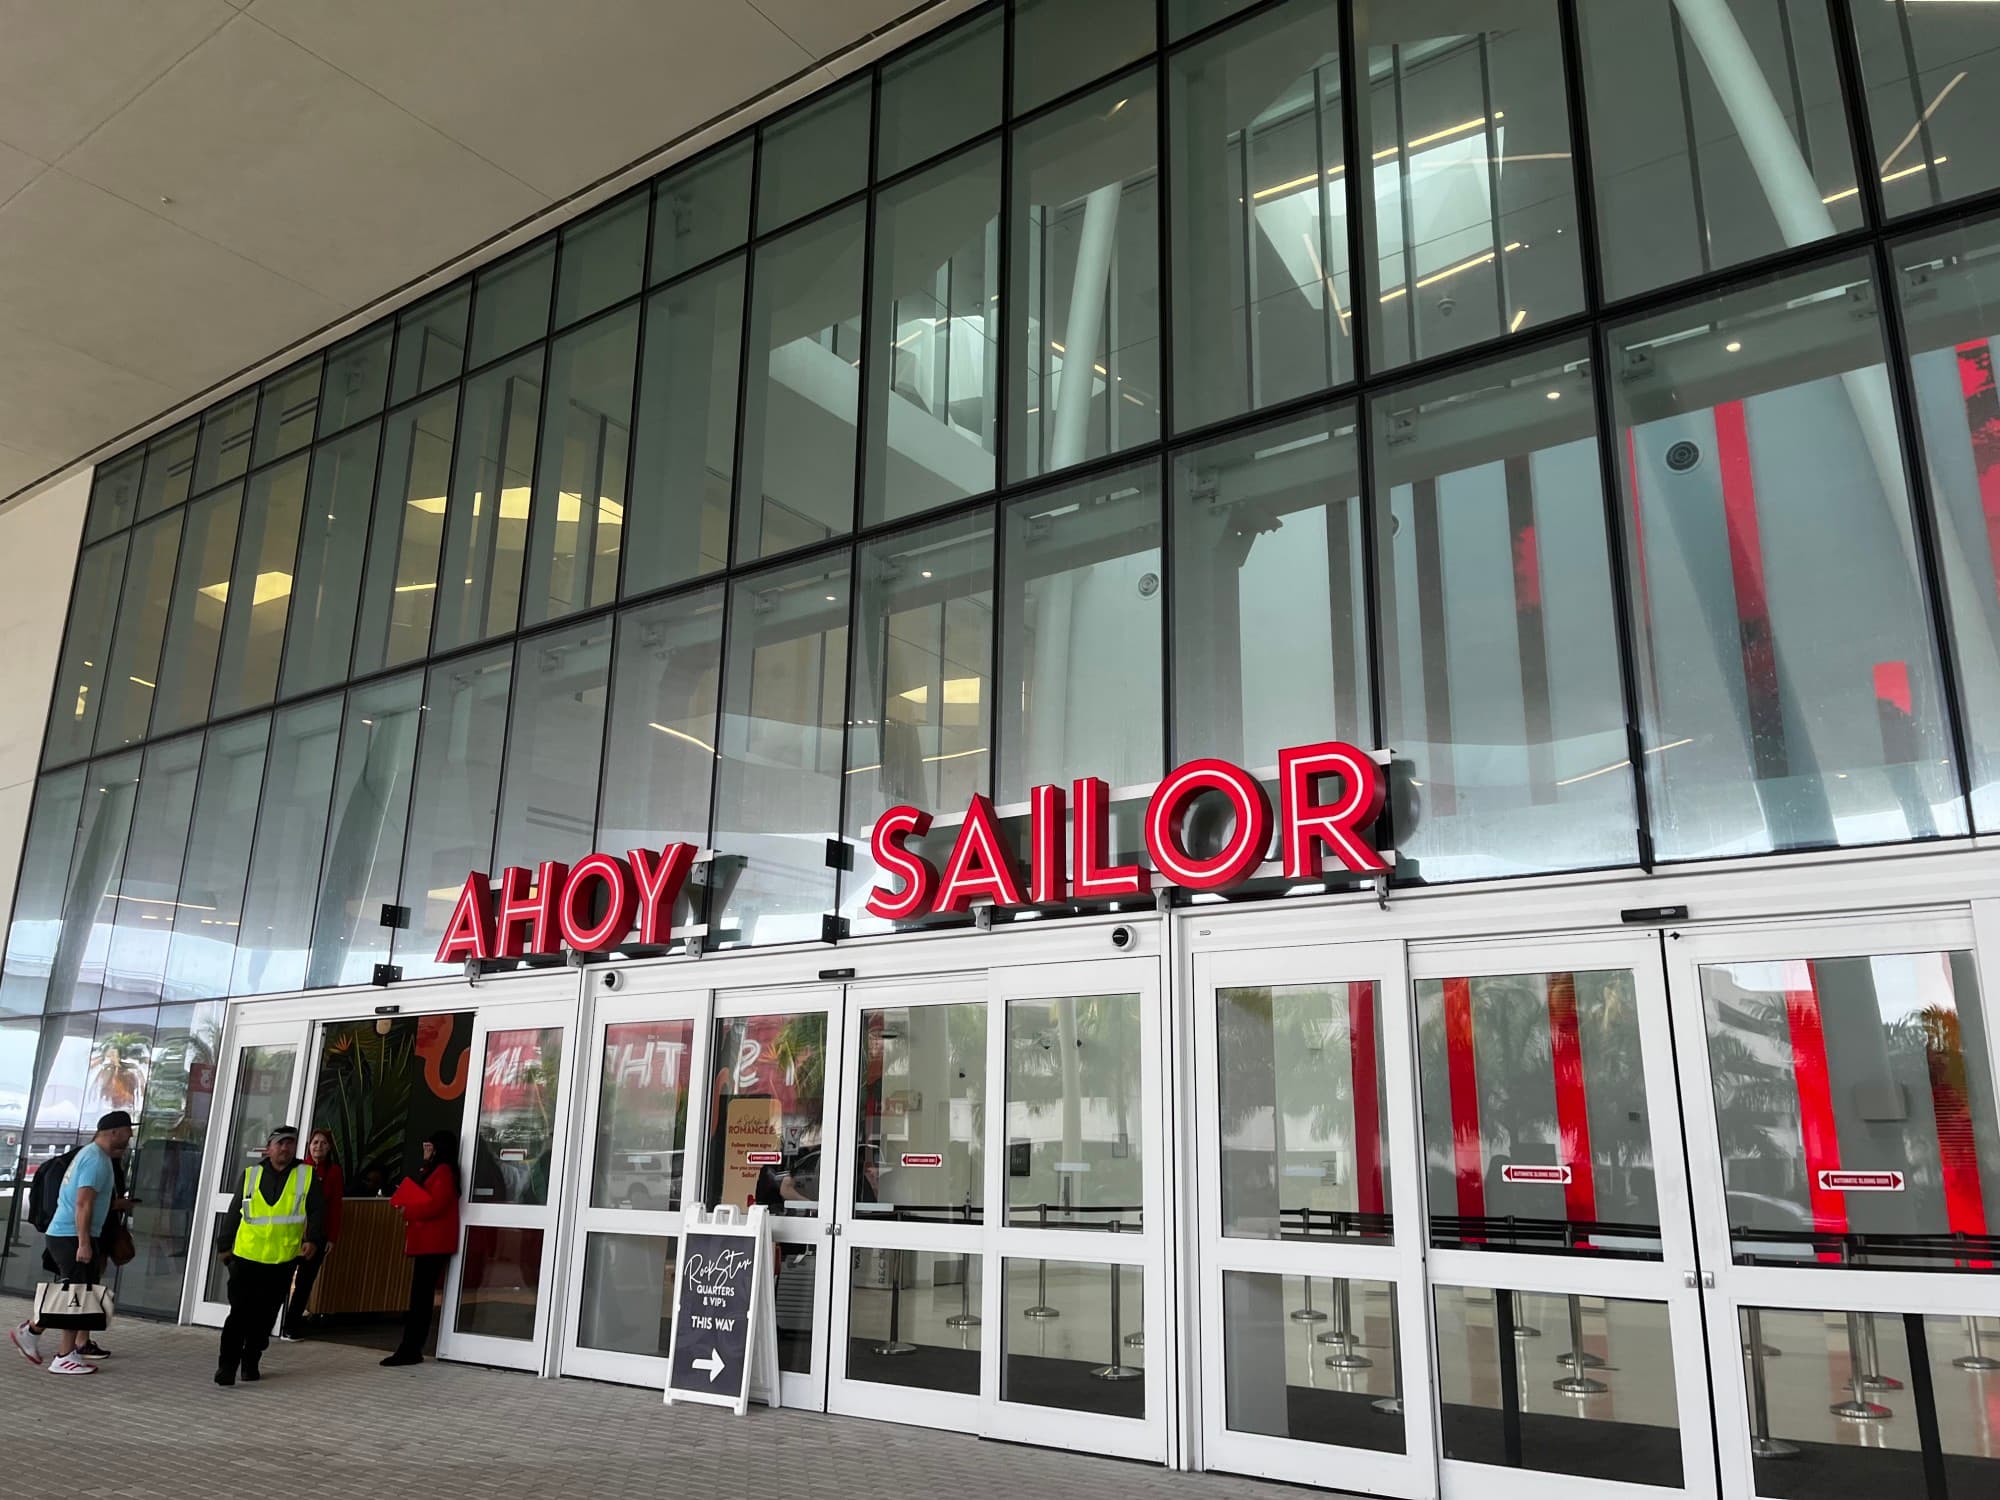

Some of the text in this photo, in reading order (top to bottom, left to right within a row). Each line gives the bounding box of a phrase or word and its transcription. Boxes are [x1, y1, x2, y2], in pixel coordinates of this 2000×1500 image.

[865, 741, 1393, 922] SAILOR
[435, 843, 698, 963] AHOY
[696, 1284, 735, 1297] QUARTERS
[67, 1292, 82, 1308] A
[703, 1297, 726, 1308] & VIP's
[691, 1315, 735, 1332] THIS WAY
